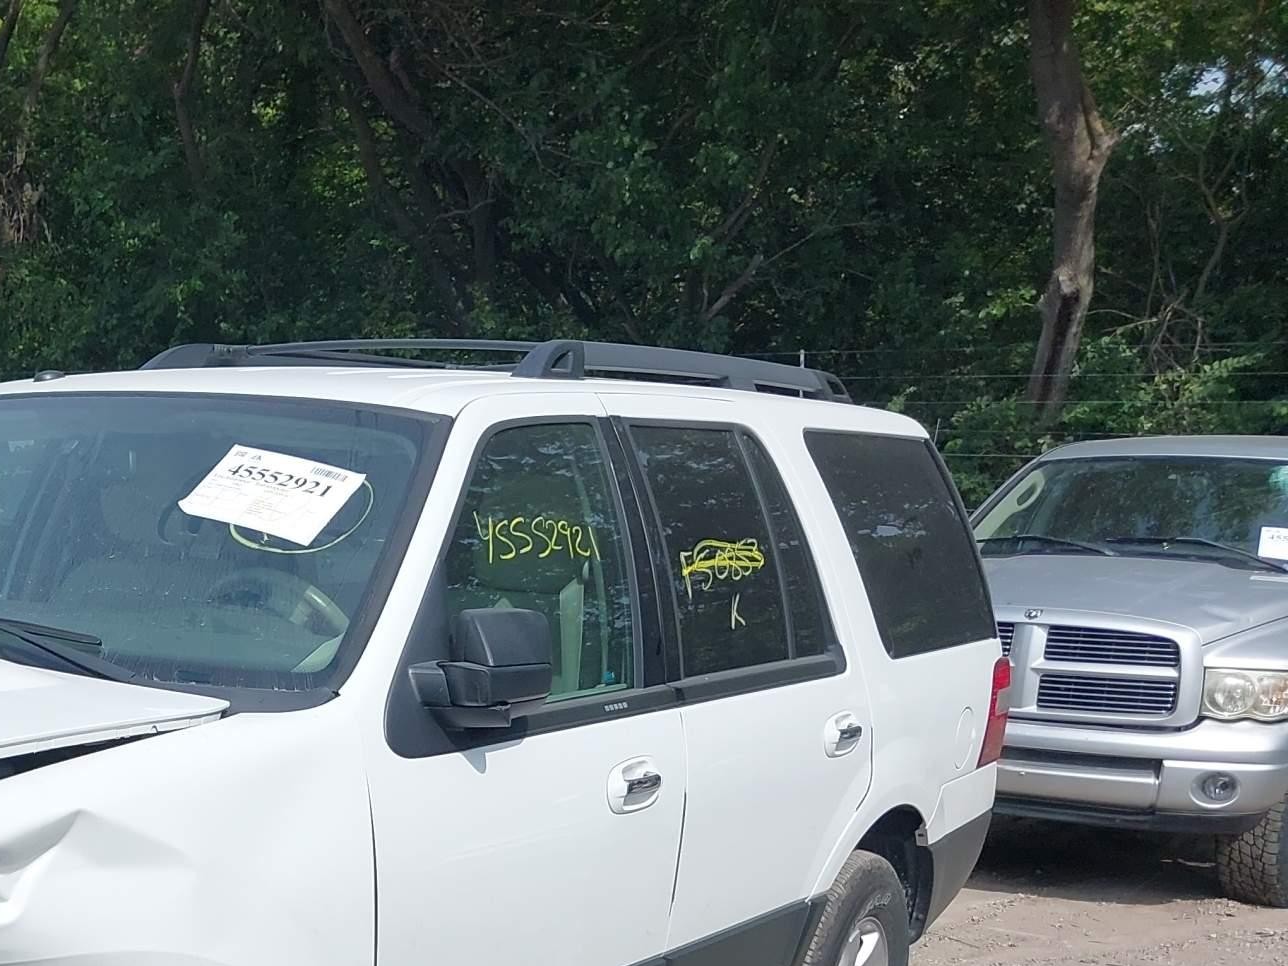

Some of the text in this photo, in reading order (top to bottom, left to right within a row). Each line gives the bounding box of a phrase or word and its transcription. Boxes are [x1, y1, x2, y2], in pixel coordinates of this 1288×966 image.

[228, 464, 332, 497] 45552921
[473, 510, 601, 564] 45552921
[731, 593, 746, 630] K
